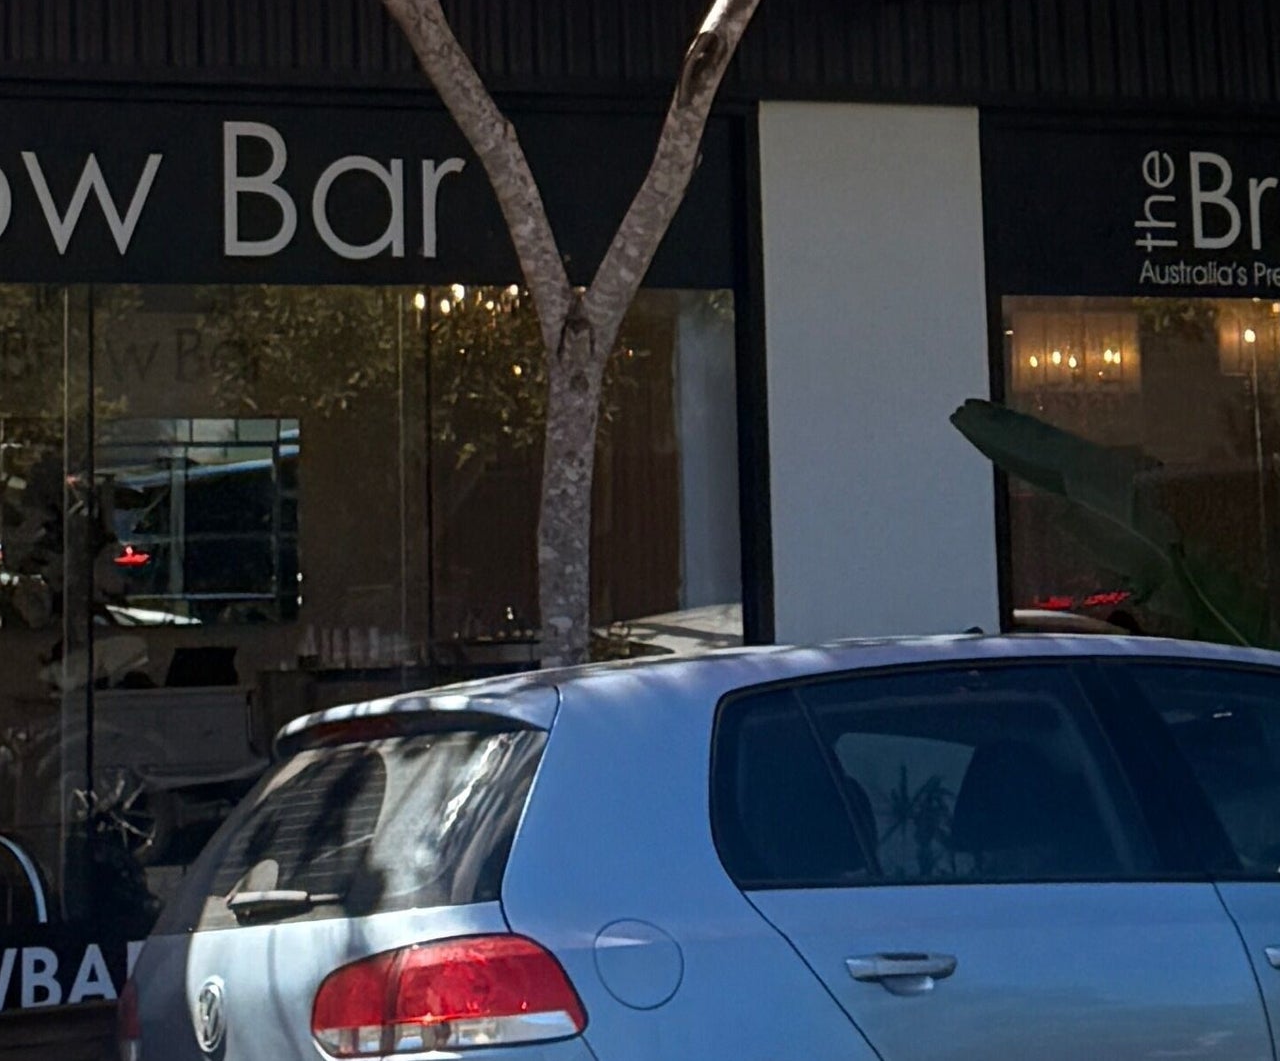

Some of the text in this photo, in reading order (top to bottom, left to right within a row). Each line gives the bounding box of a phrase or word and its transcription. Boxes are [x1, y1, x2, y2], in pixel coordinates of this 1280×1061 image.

[222, 121, 465, 259] Bar
[1134, 150, 1177, 252] the
[1139, 259, 1248, 287] Australia's
